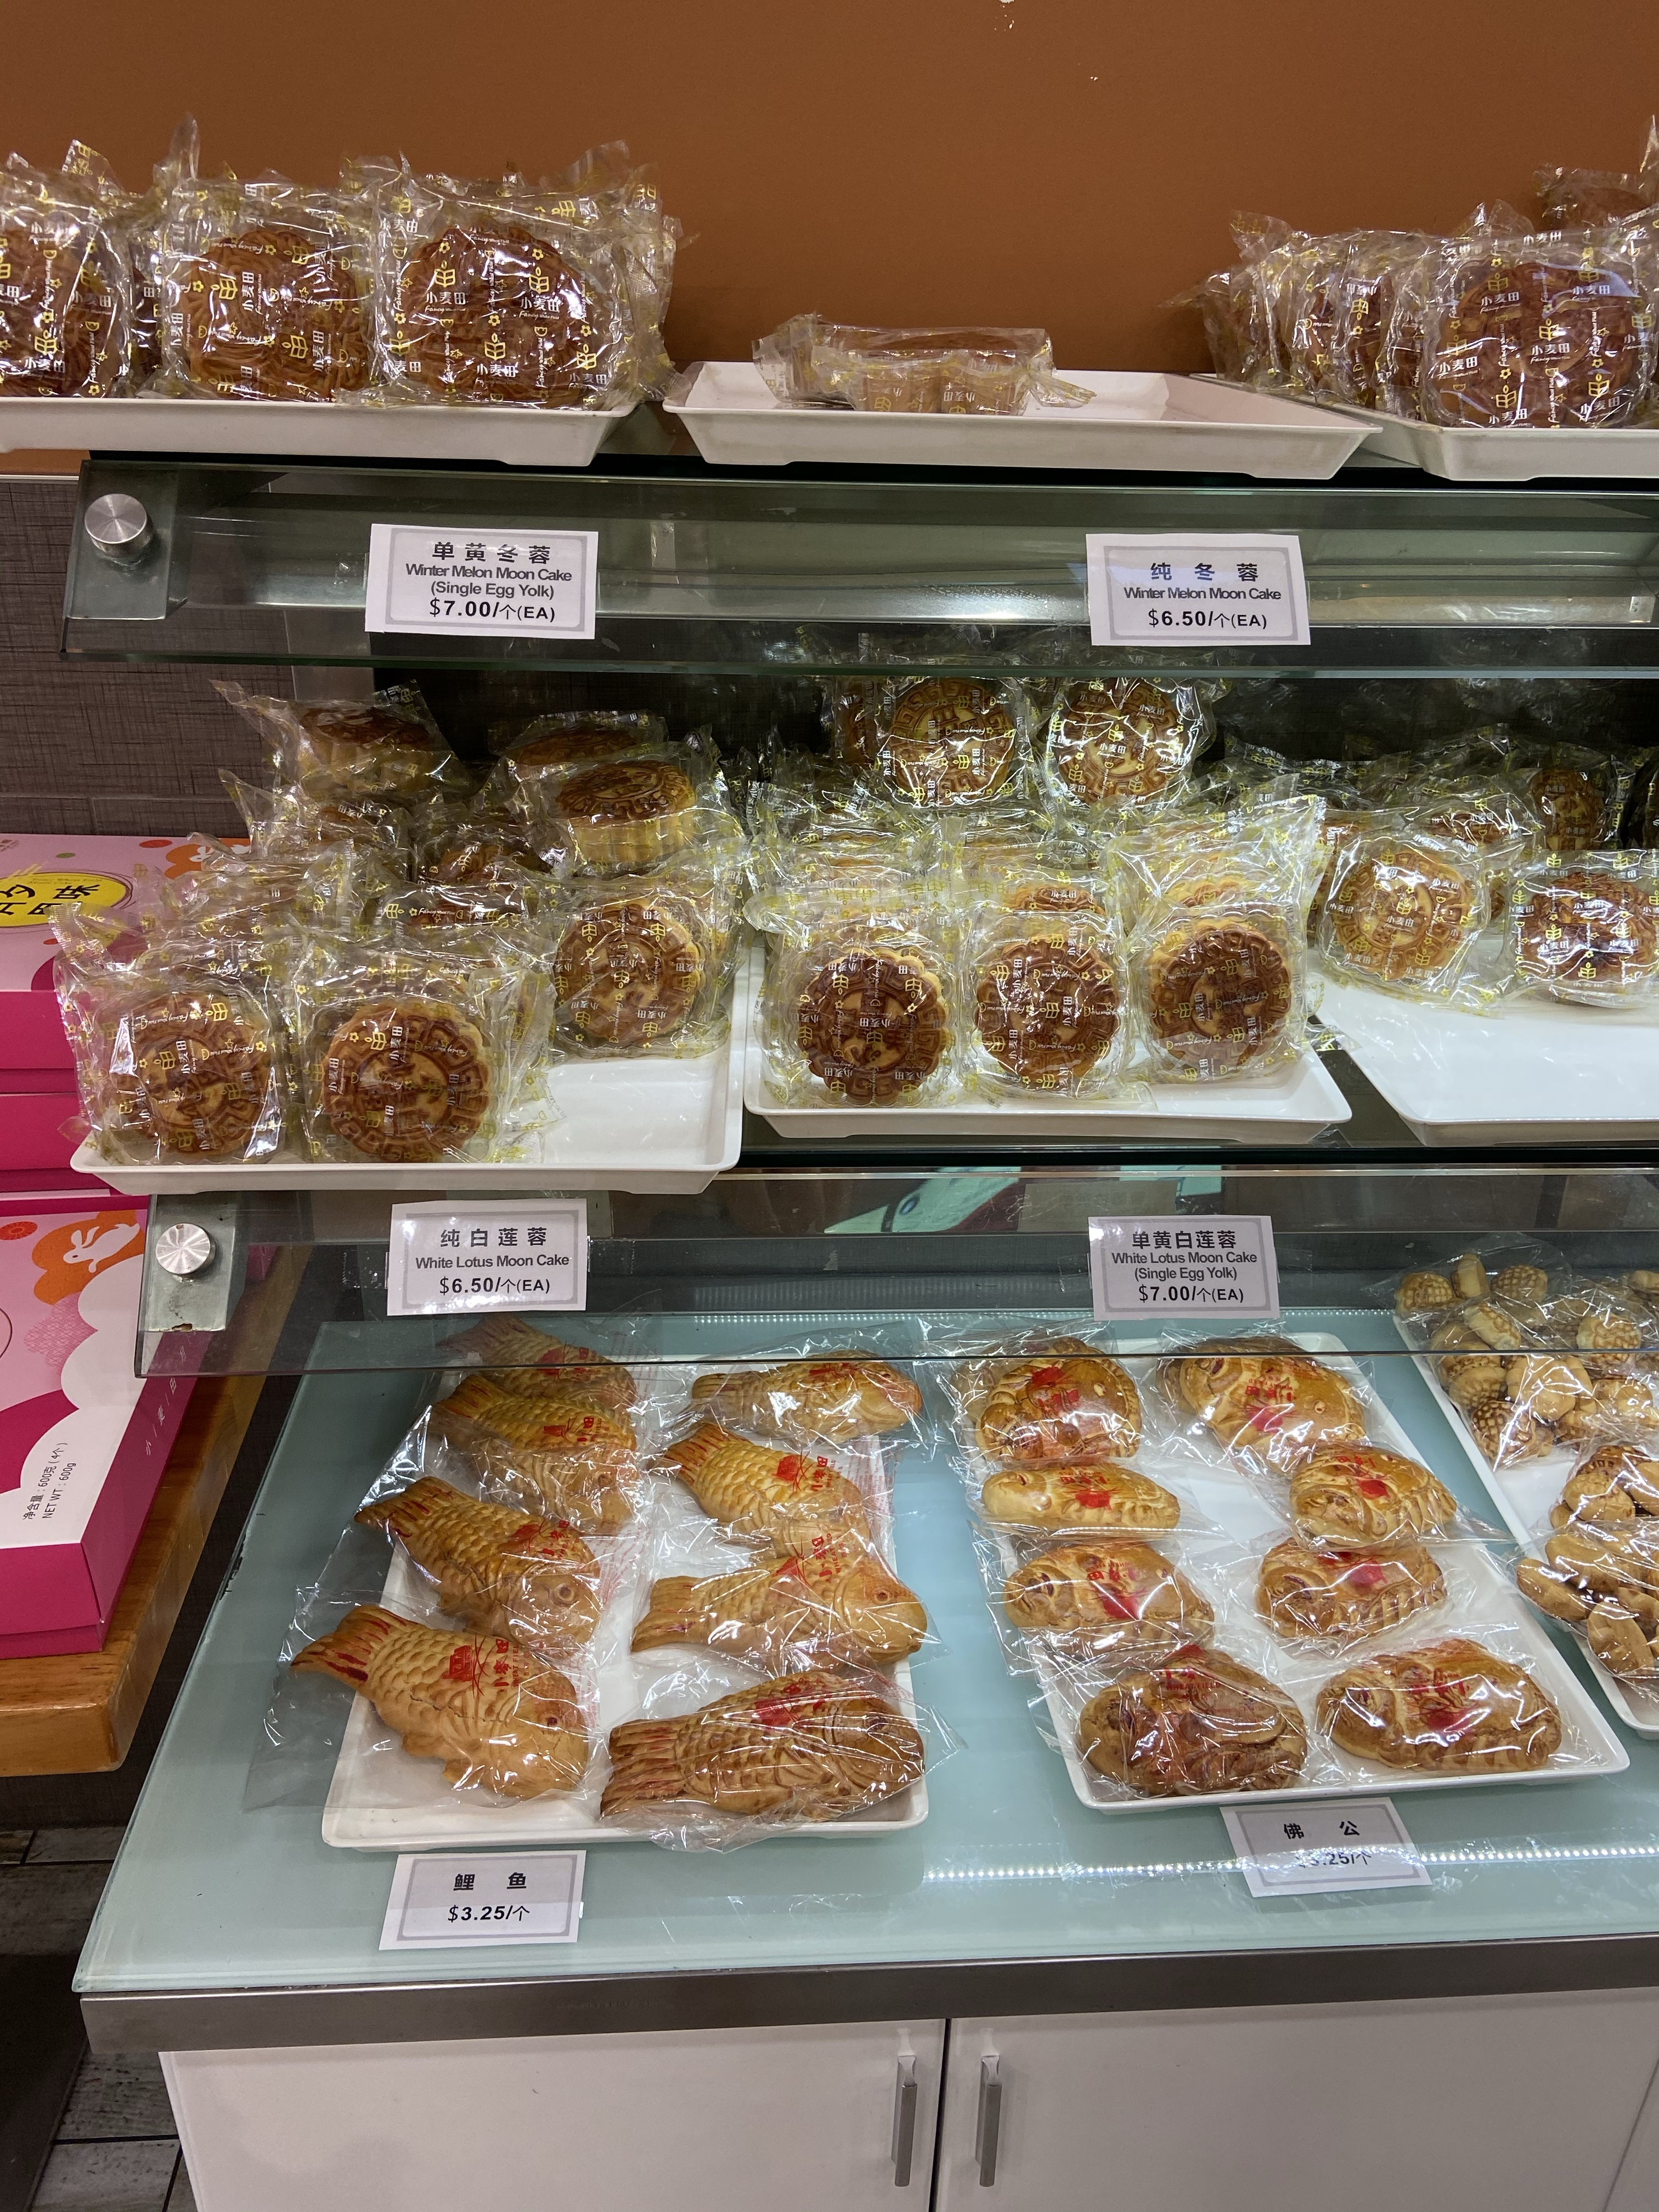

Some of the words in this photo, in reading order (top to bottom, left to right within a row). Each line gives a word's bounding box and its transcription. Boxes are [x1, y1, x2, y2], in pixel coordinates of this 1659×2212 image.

[1523, 230, 1562, 245] 小麦田
[242, 271, 255, 311] 小麦田
[393, 283, 405, 312] Fancy
[1572, 285, 1610, 295] 小麦田
[426, 292, 466, 305] 小麦田
[521, 297, 560, 312] 小麦田
[1482, 291, 1519, 306] 小麦田
[425, 305, 445, 313] Fancy
[519, 311, 538, 320] Fancy
[312, 330, 324, 371] 小麦田
[1531, 343, 1570, 356] 小麦田
[1440, 356, 1477, 374] 小麦田
[1531, 356, 1553, 364] Fancy
[477, 363, 516, 377] 小麦田
[569, 373, 607, 385] 小麦田
[1489, 409, 1528, 424] 小麦田
[1549, 400, 1560, 423] Fancy
[432, 541, 551, 565] 单黄冬蓉
[405, 563, 450, 577] Winter
[452, 565, 493, 578] Melon
[496, 567, 534, 579] Moon
[538, 568, 572, 581] Cake
[1150, 562, 1259, 582] 纯冬蓉
[431, 580, 482, 596] (Single
[486, 583, 515, 599] Egg
[519, 584, 554, 600] Yolk)
[1124, 587, 1166, 599] Winter
[1168, 587, 1206, 599] Melon
[1210, 588, 1246, 599] Moon
[1249, 588, 1282, 600] Cake
[1139, 704, 1165, 715] 小麦田
[1099, 743, 1126, 754] 小麦田
[972, 748, 980, 775] 小麦田
[1432, 878, 1460, 889] 小麦田
[1330, 903, 1354, 915] 小麦田
[1387, 916, 1414, 927] 小麦田
[1345, 952, 1372, 964] 小麦田
[874, 959, 884, 982] Fancy
[1013, 958, 1023, 989] 小麦田
[1406, 967, 1434, 978] 小麦田
[1243, 994, 1260, 1003] Fancy
[637, 1009, 668, 1019] 小麦田
[1063, 996, 1073, 1026] 小麦田
[1194, 993, 1206, 1022] 小麦田
[860, 1018, 890, 1028] 小麦田
[1247, 1017, 1259, 1046] 小麦田
[389, 1026, 403, 1060] 小麦田
[1008, 1029, 1018, 1060] 小麦田
[1194, 1035, 1213, 1045] Fancy
[232, 1045, 254, 1054] Fancy
[329, 1058, 340, 1092] 小麦田
[824, 1067, 853, 1078] 小麦田
[895, 1071, 926, 1081] 小麦田
[441, 1227, 547, 1248] 纯白莲蓉
[1132, 1231, 1237, 1249] 单黄白莲蓉
[416, 1256, 453, 1269] White
[456, 1256, 493, 1268] Lotus
[496, 1255, 533, 1267] Moon
[537, 1254, 569, 1266] Cake
[1112, 1252, 1147, 1263] White
[1150, 1252, 1185, 1263] Lotus
[1188, 1252, 1223, 1263] Moon
[1226, 1252, 1257, 1263] Cake
[1135, 1267, 1177, 1282] (Single
[1180, 1267, 1204, 1282] Egg
[1207, 1267, 1237, 1281] Yolk)
[42, 1503, 57, 1519] NET
[830, 1547, 842, 1575] WHEAT
[454, 1872, 527, 1891] 鲤鱼
[448, 1905, 530, 1922] $3.25/个
